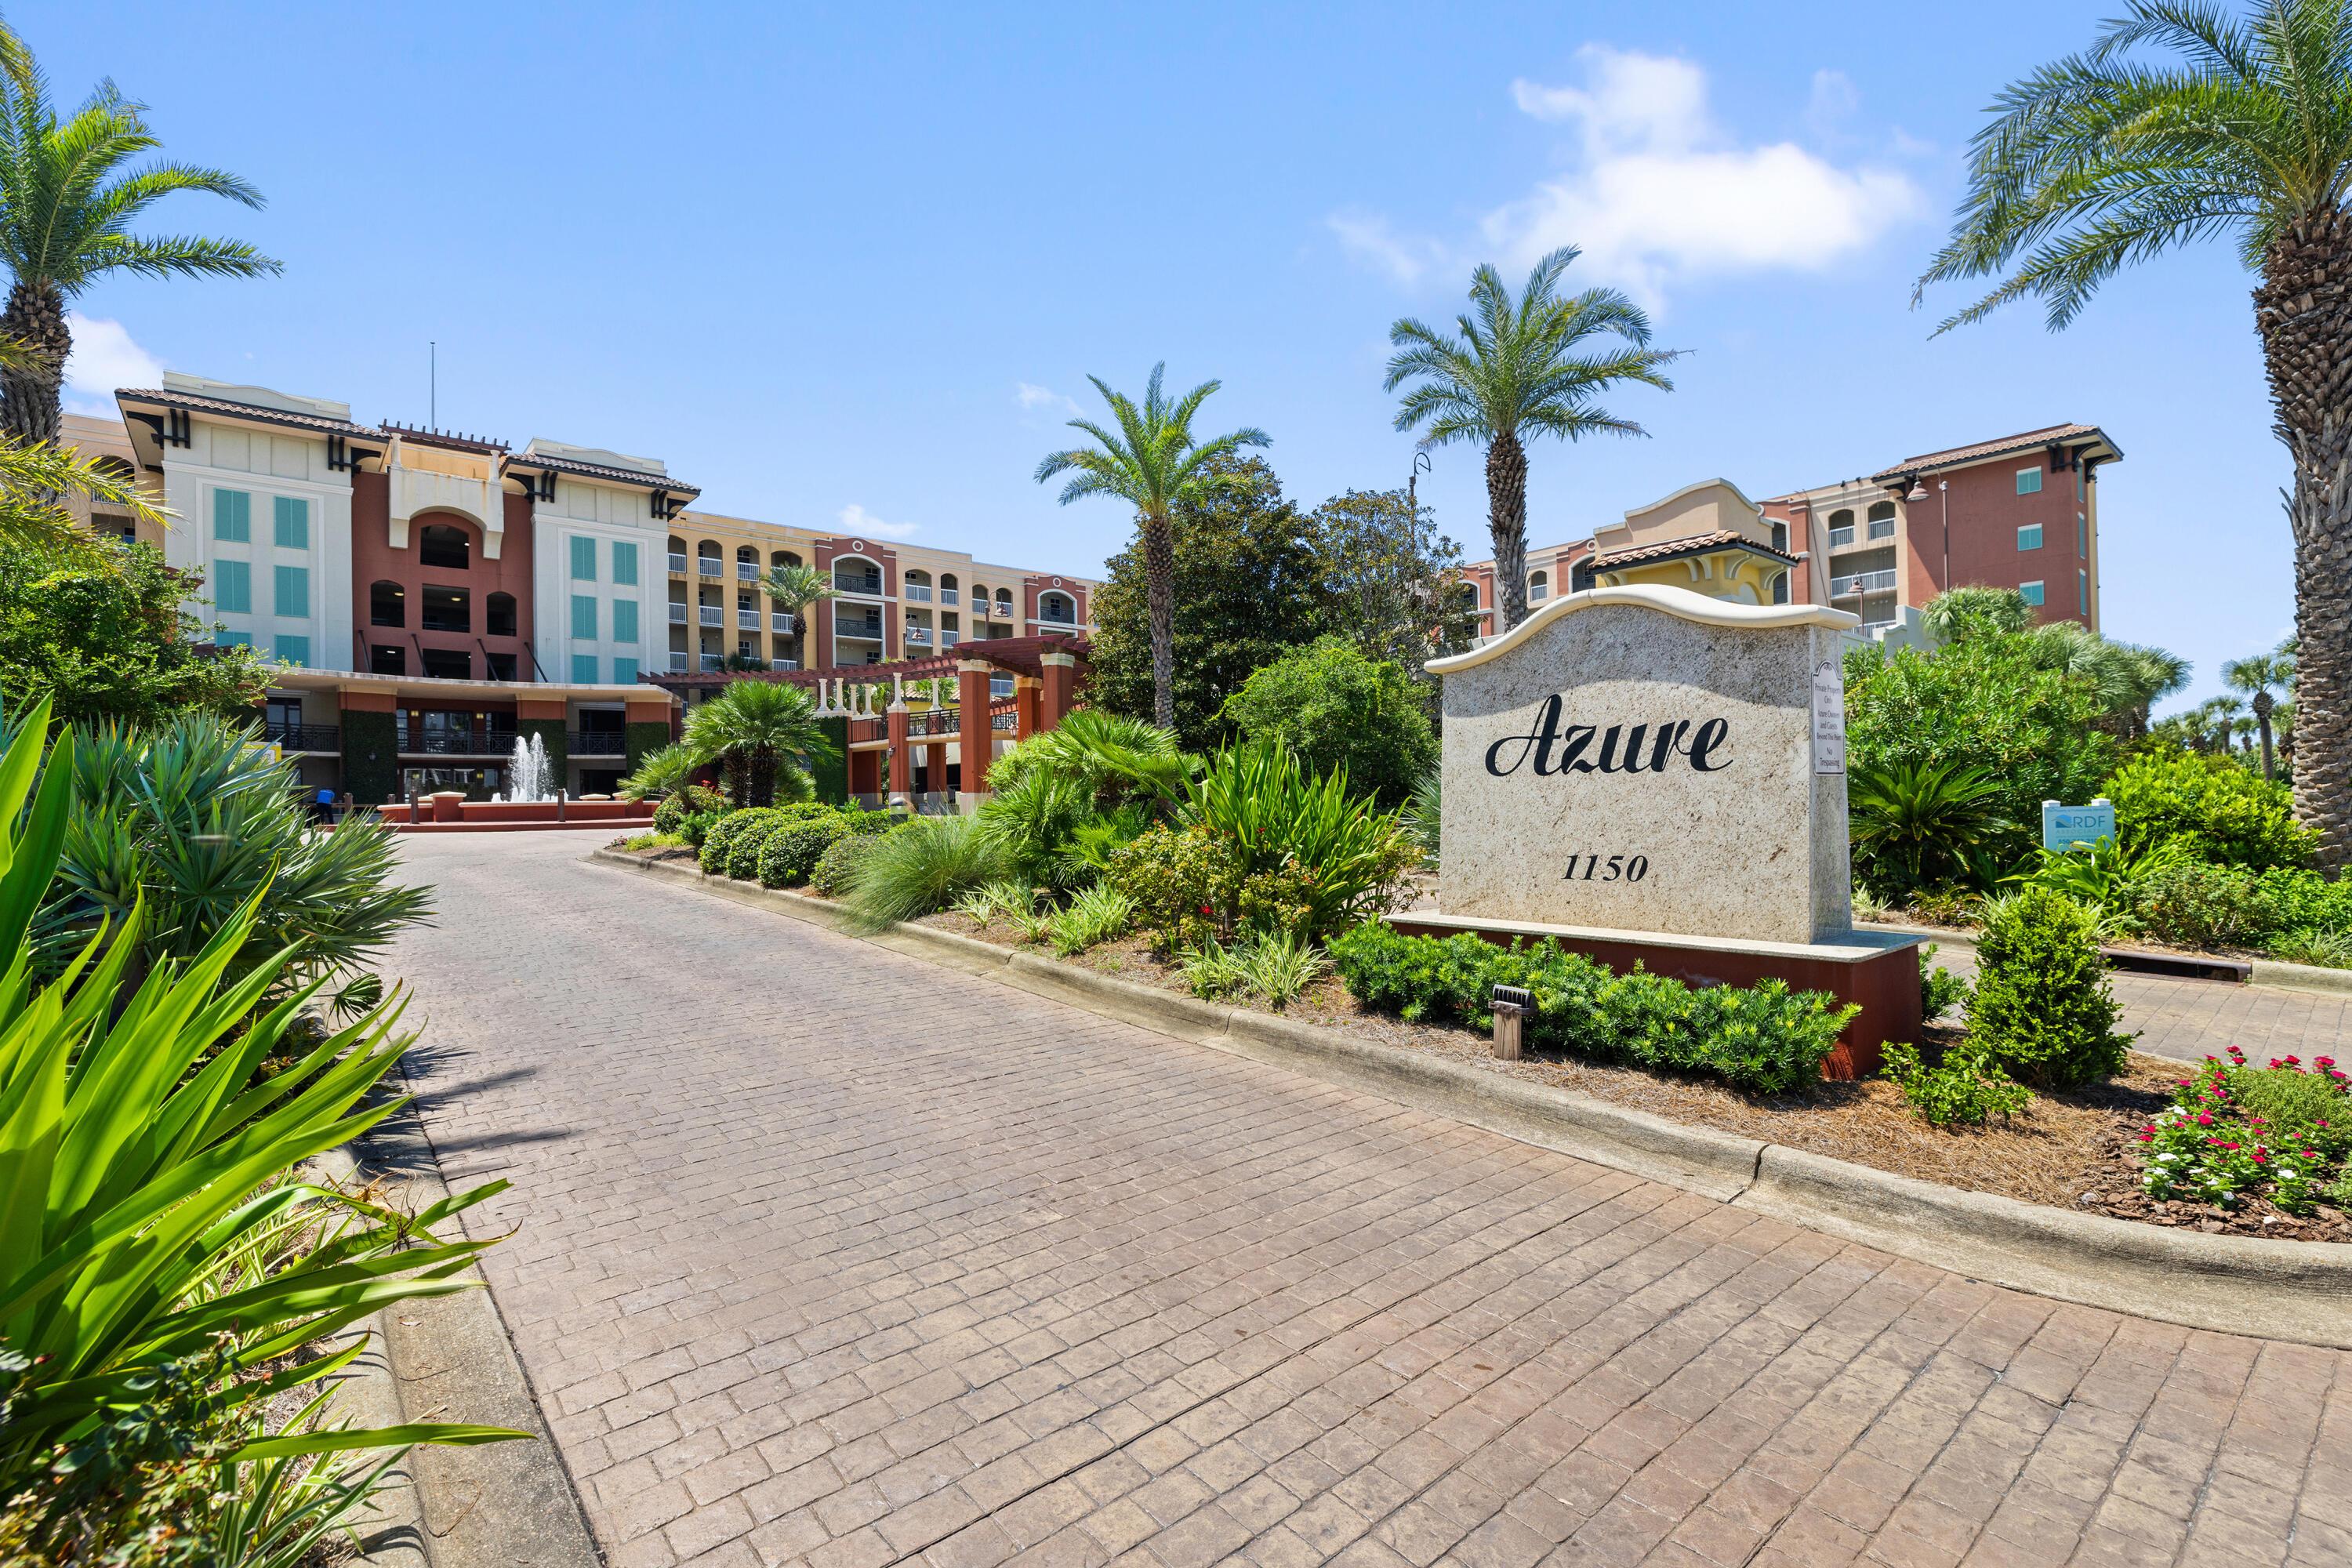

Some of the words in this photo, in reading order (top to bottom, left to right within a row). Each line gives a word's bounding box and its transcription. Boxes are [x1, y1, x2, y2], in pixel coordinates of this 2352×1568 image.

[1827, 685, 1841, 695] Property
[1818, 709, 1827, 718] Azure
[1828, 710, 1840, 719] Owners
[1485, 694, 1733, 776] Azure
[1827, 747, 1833, 756] No
[1820, 757, 1840, 768] Trespassing
[2074, 815, 2106, 828] RDF
[1561, 855, 1648, 882] 1150
